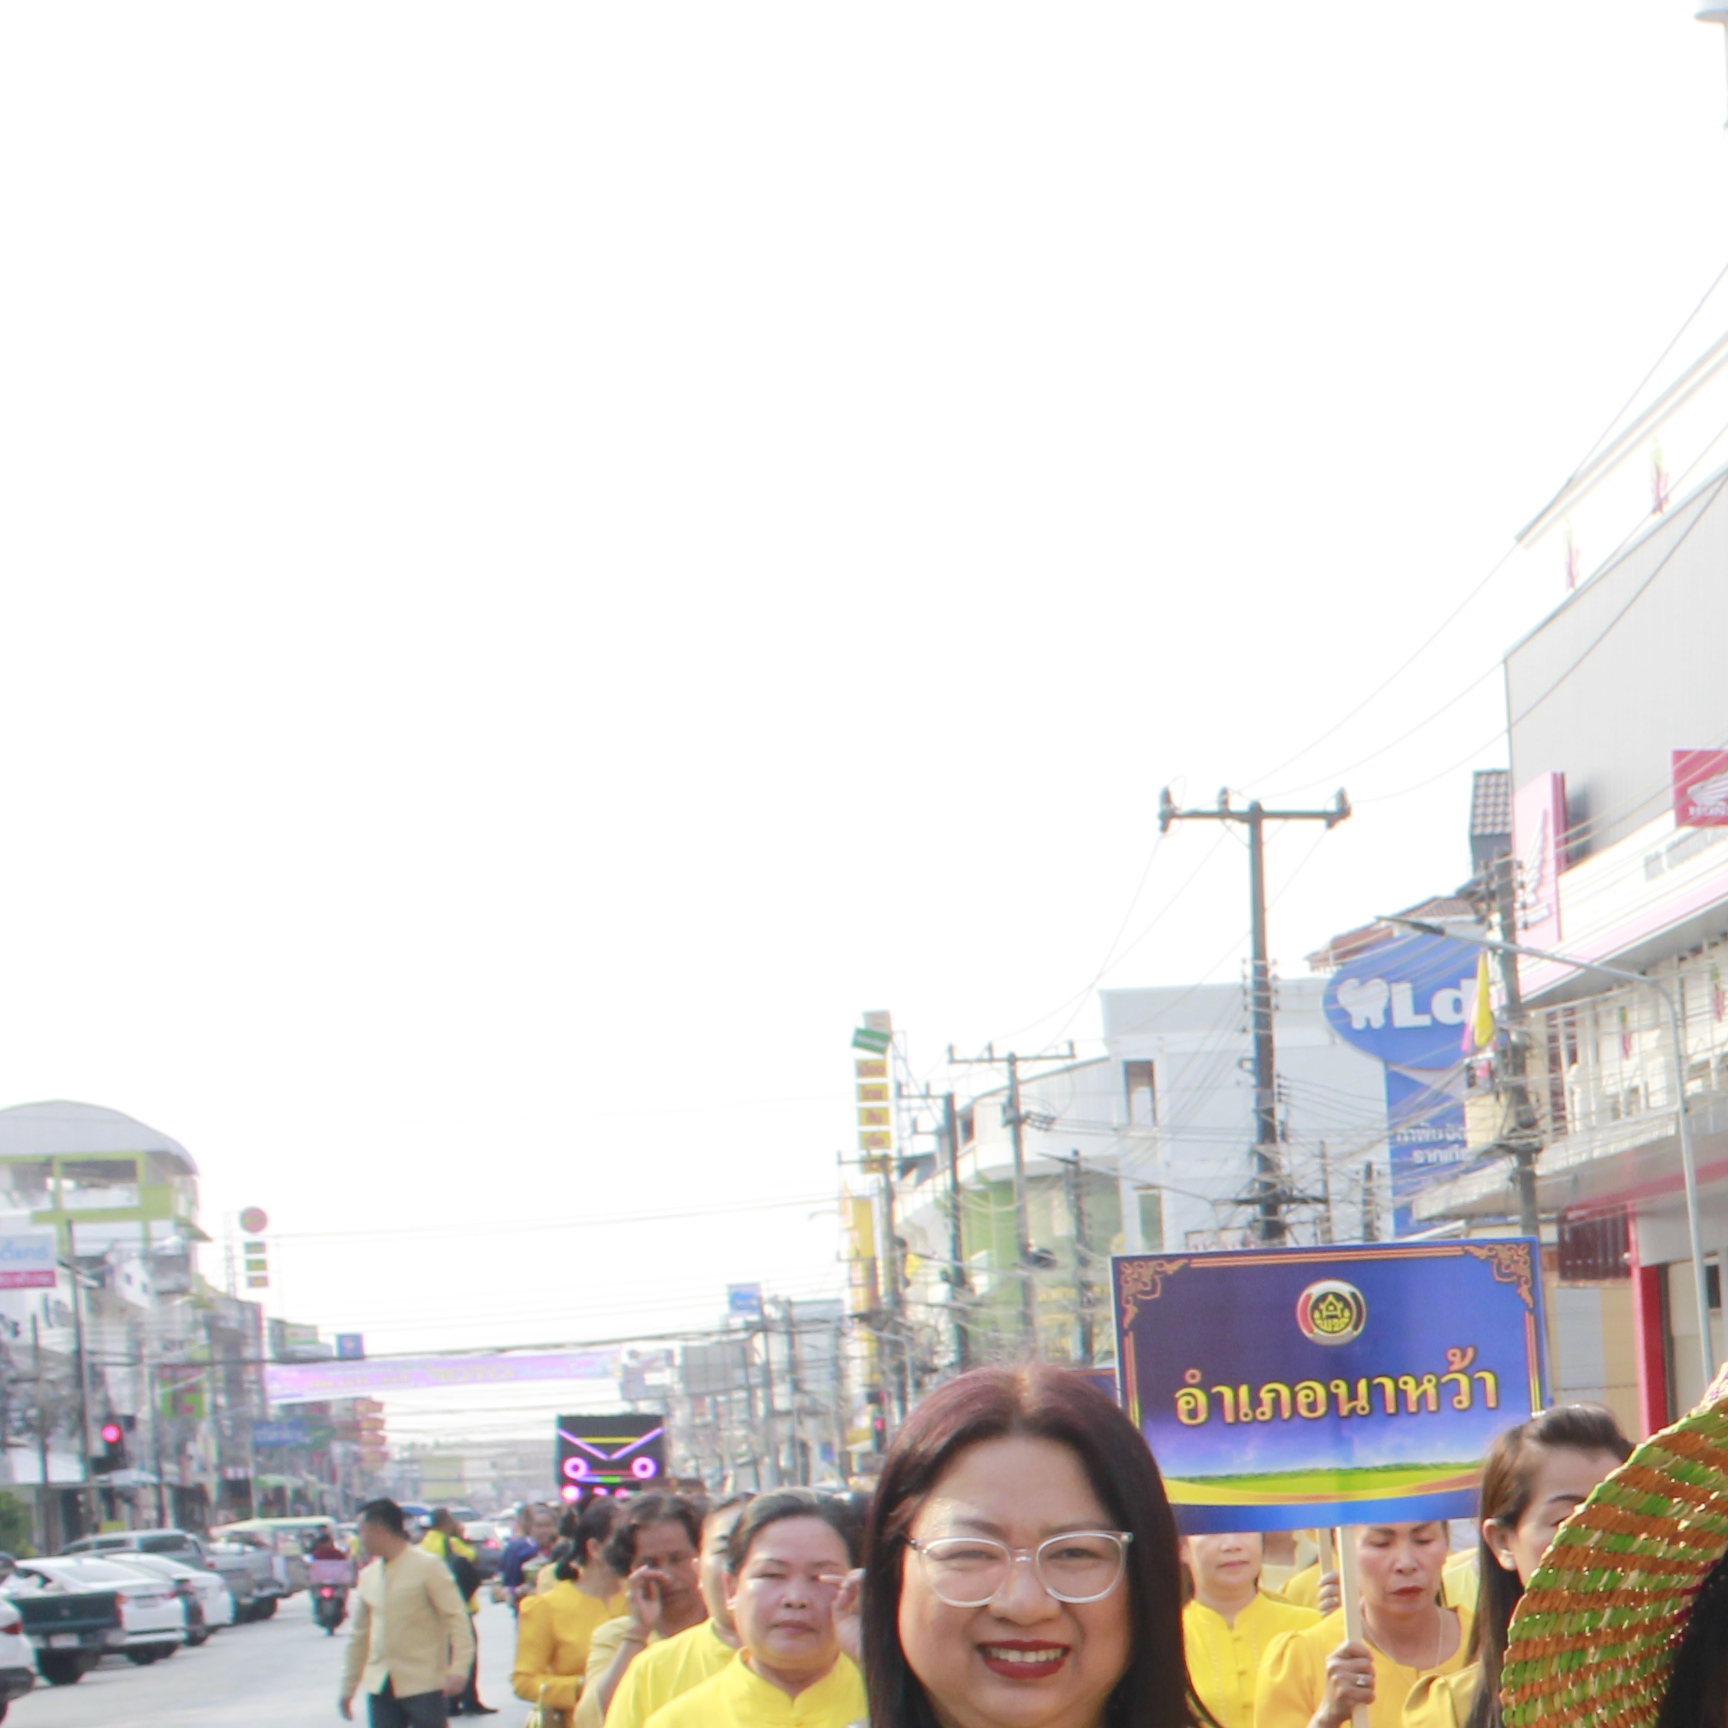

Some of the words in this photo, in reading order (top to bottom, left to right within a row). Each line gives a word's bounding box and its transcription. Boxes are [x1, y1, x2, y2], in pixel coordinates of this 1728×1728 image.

[1390, 977, 1478, 1030] Ld
[1174, 1345, 1499, 1427] อำเภอนาหว้า
